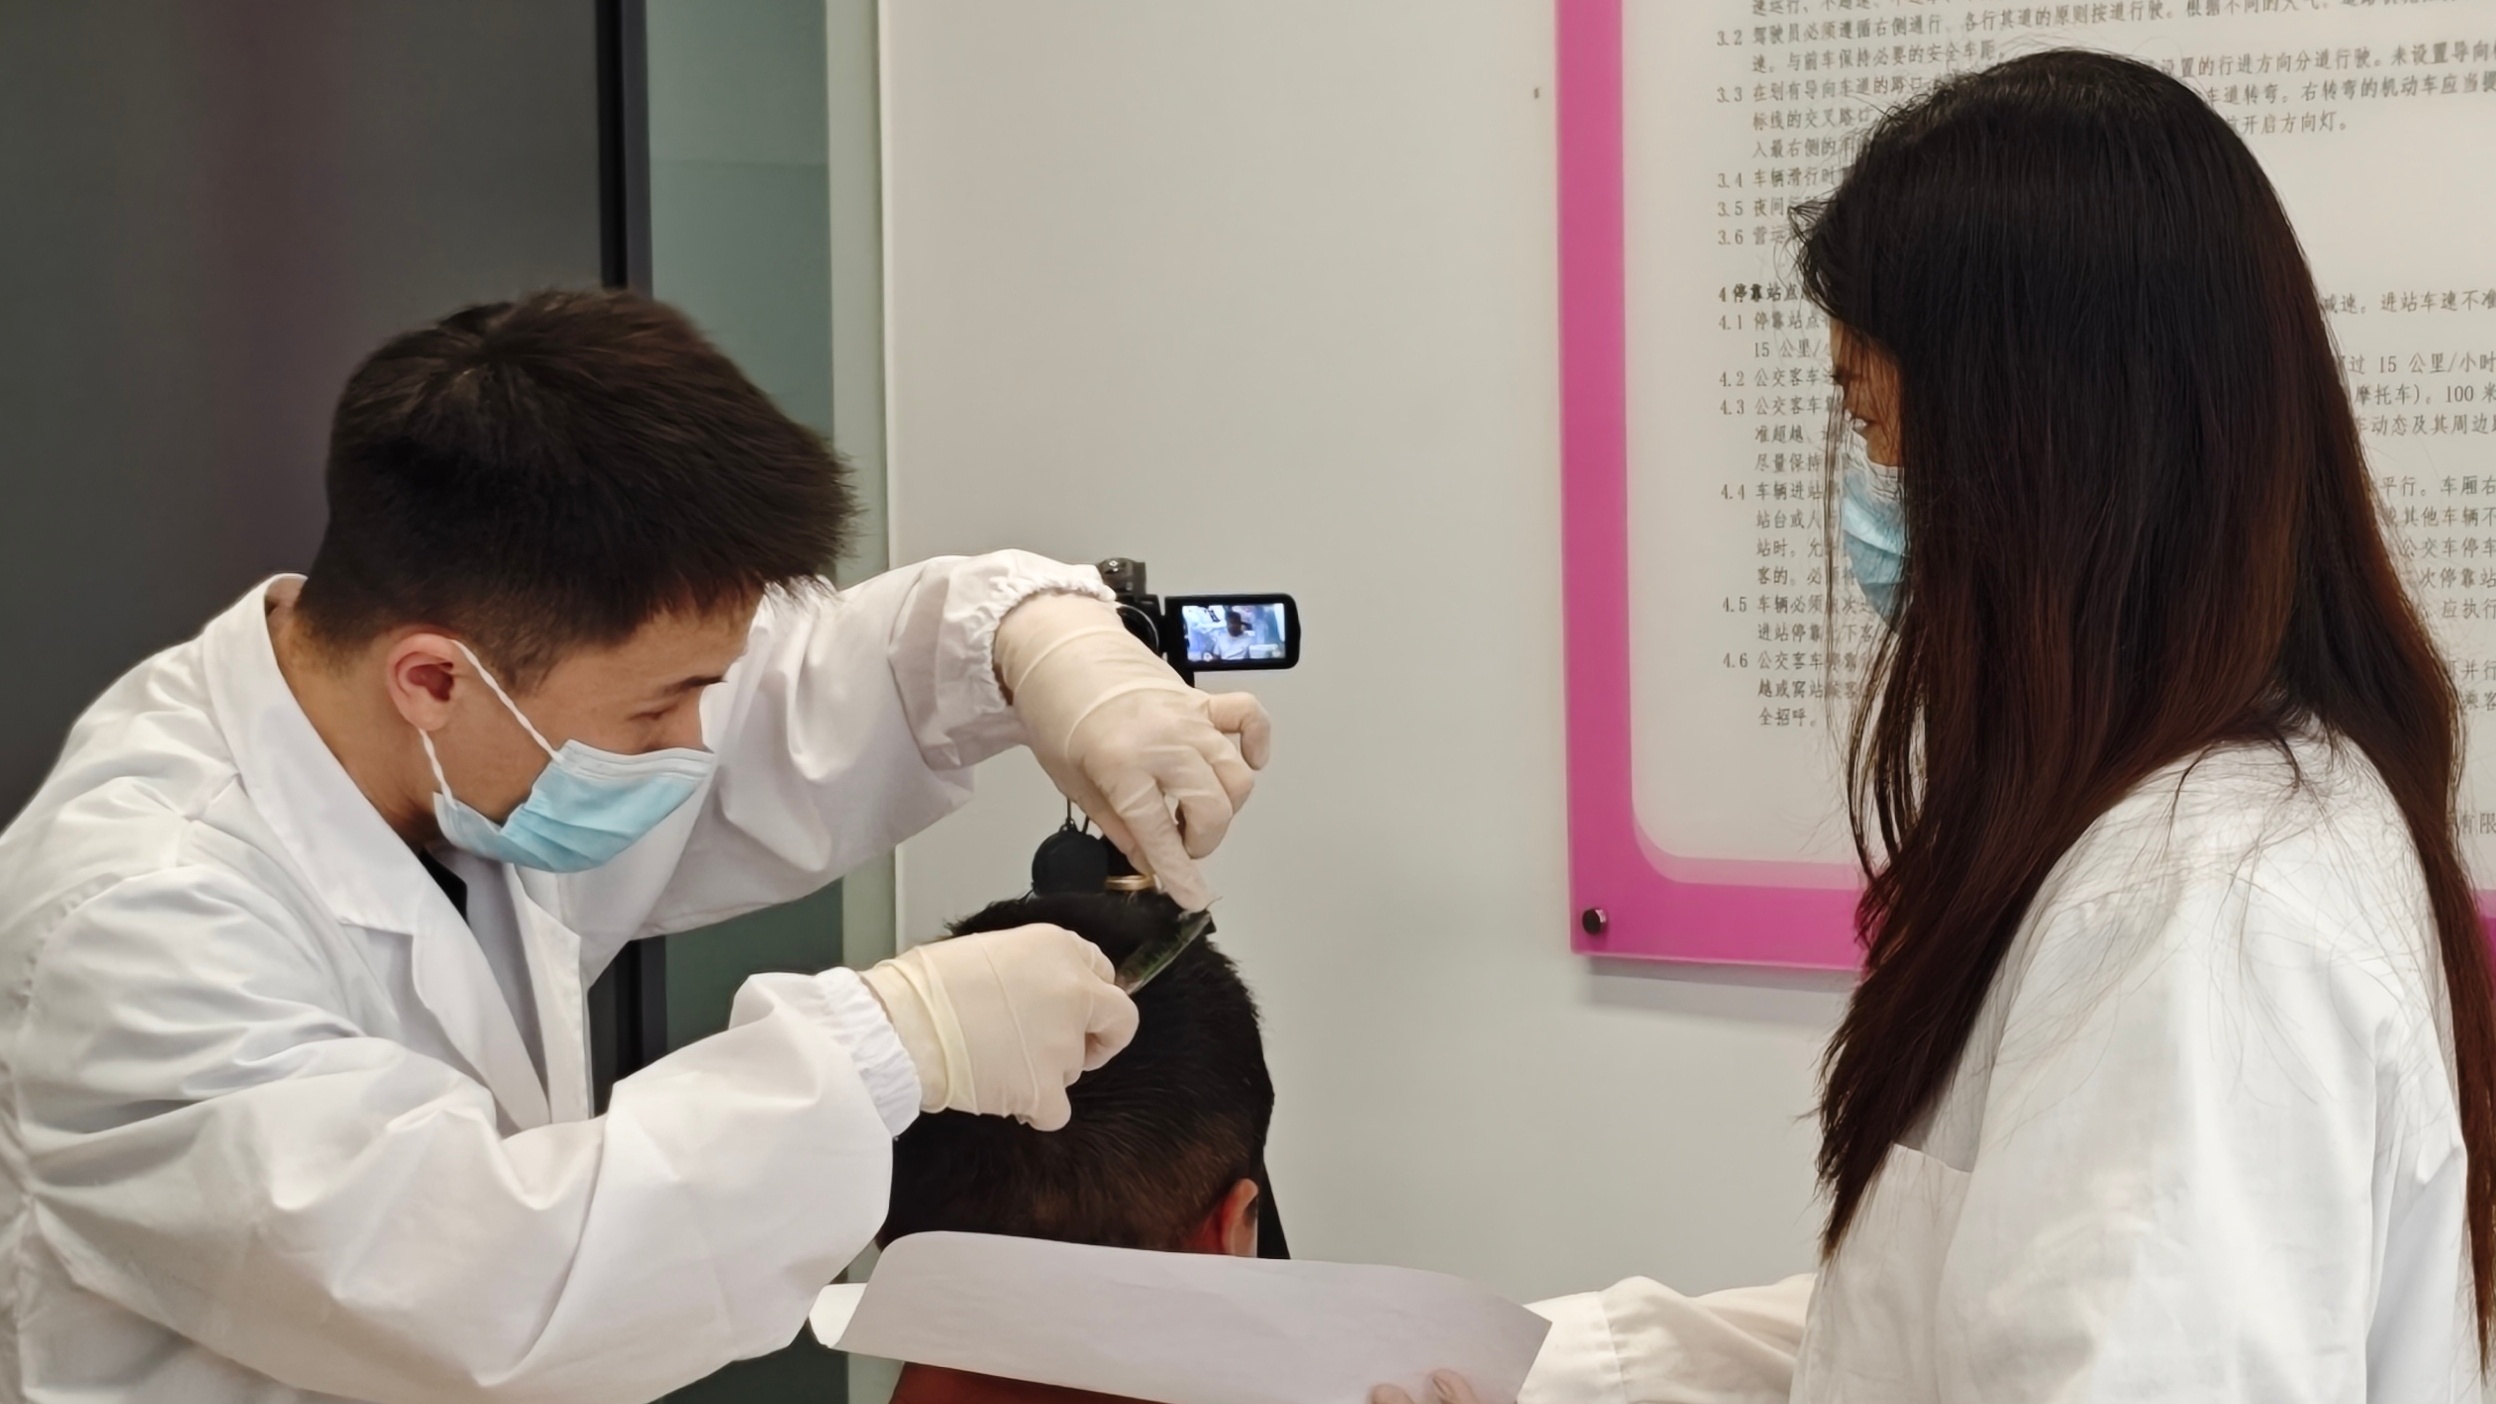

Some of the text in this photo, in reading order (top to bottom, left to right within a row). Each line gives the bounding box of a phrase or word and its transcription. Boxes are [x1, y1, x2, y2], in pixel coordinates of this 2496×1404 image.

[1717, 30, 1742, 46] 3.2
[1717, 87, 1742, 103] 3.3
[1717, 172, 1743, 188] 3.4
[1717, 201, 1743, 217] 3.5
[1717, 229, 1744, 246] 3.6
[1718, 286, 1727, 302] 4
[1718, 314, 1743, 331] 4.1
[1754, 341, 1770, 358] 15
[2380, 355, 2397, 373] 15
[1719, 370, 1745, 388] 4.2
[2446, 384, 2475, 403] 100
[1720, 399, 1745, 416] 4.3
[1720, 484, 1746, 501] 4.4
[1722, 596, 1748, 613] 4.5
[1723, 652, 1748, 669] 4.6
